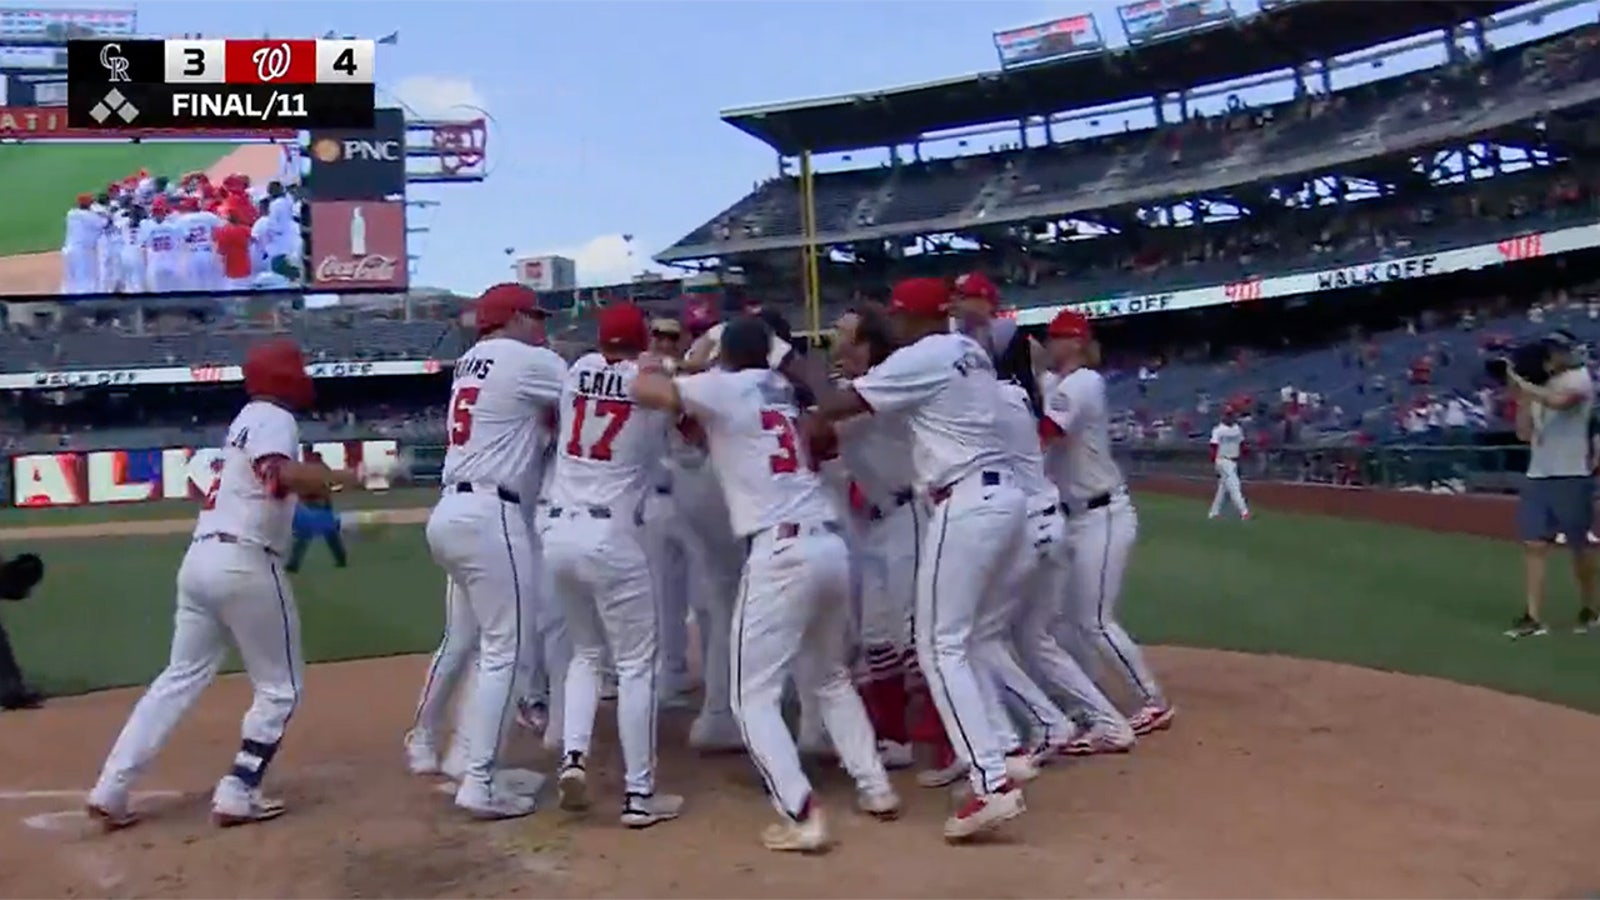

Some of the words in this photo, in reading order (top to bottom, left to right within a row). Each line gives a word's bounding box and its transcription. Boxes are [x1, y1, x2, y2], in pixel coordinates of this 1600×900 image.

[343, 139, 400, 161] PNC
[1317, 266, 1379, 291] WALK
[1386, 255, 1437, 280] OFF
[1129, 295, 1174, 313] OFF
[567, 395, 634, 461] 17
